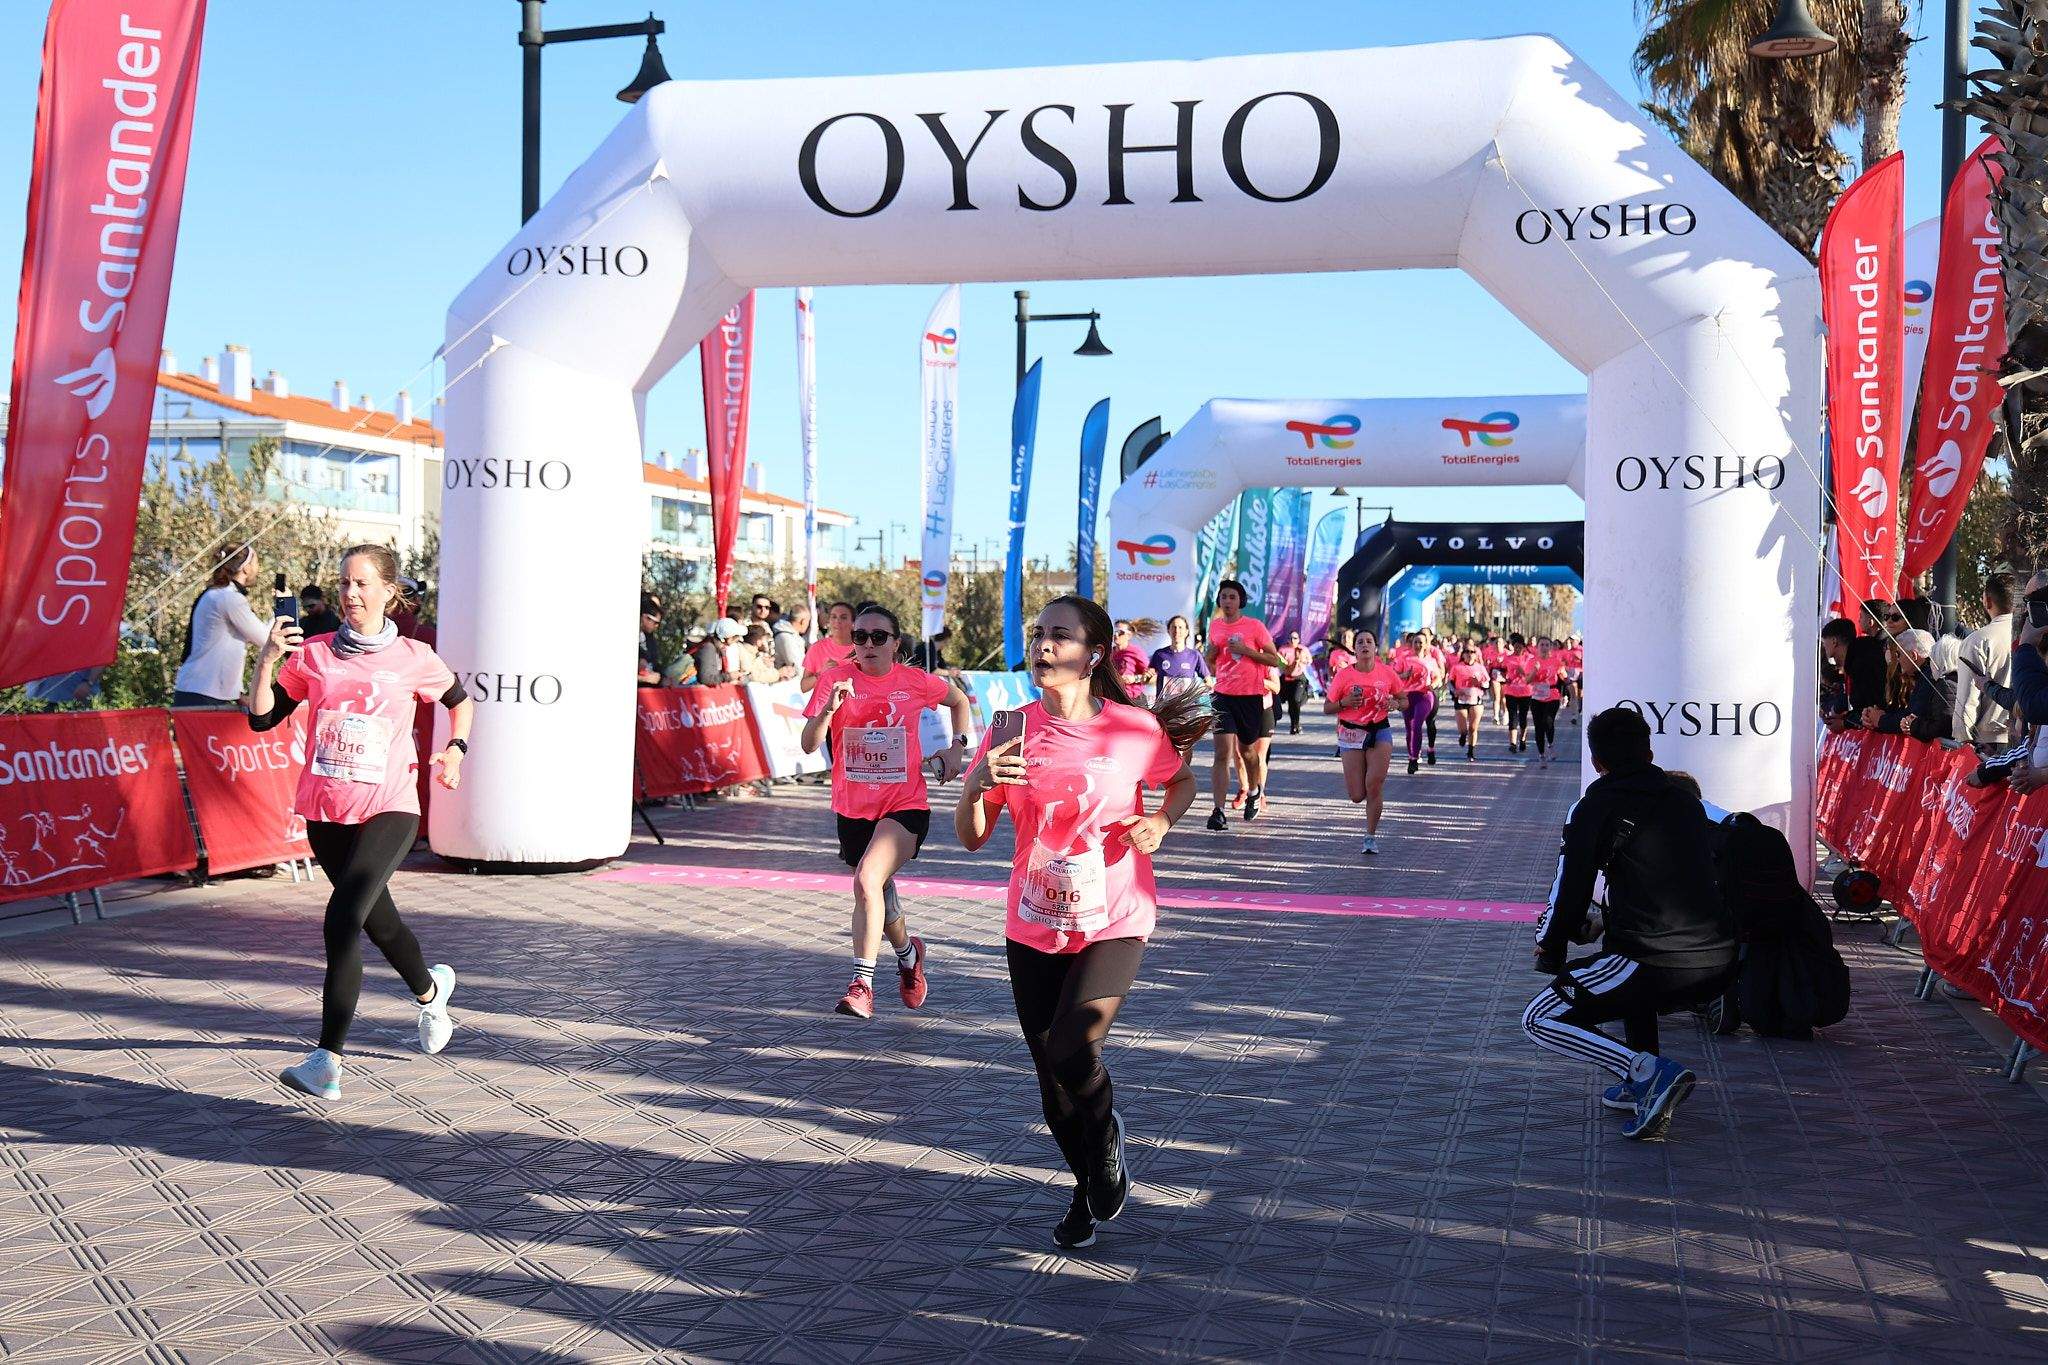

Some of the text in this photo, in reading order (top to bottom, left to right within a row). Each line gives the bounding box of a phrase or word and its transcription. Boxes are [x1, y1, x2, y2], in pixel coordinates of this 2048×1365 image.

[798, 90, 1341, 218] OYSHO
[1515, 203, 1697, 246] OYSHO
[507, 245, 648, 278] OYSHO
[37, 14, 162, 626] Sports Santander
[1849, 237, 1884, 459] Santander
[445, 458, 573, 490] OYSHO
[1286, 456, 1362, 469] TotalEnergies
[1441, 454, 1520, 467] TotalEnergies
[1615, 454, 1786, 492] OYSHO
[1417, 536, 1554, 550] VOLVO
[1115, 572, 1176, 583] TotalEnergies
[0, 737, 149, 785] Santander
[206, 736, 289, 783] Sports
[338, 741, 366, 755] 016
[865, 753, 888, 762] 016
[1045, 887, 1081, 903] 016
